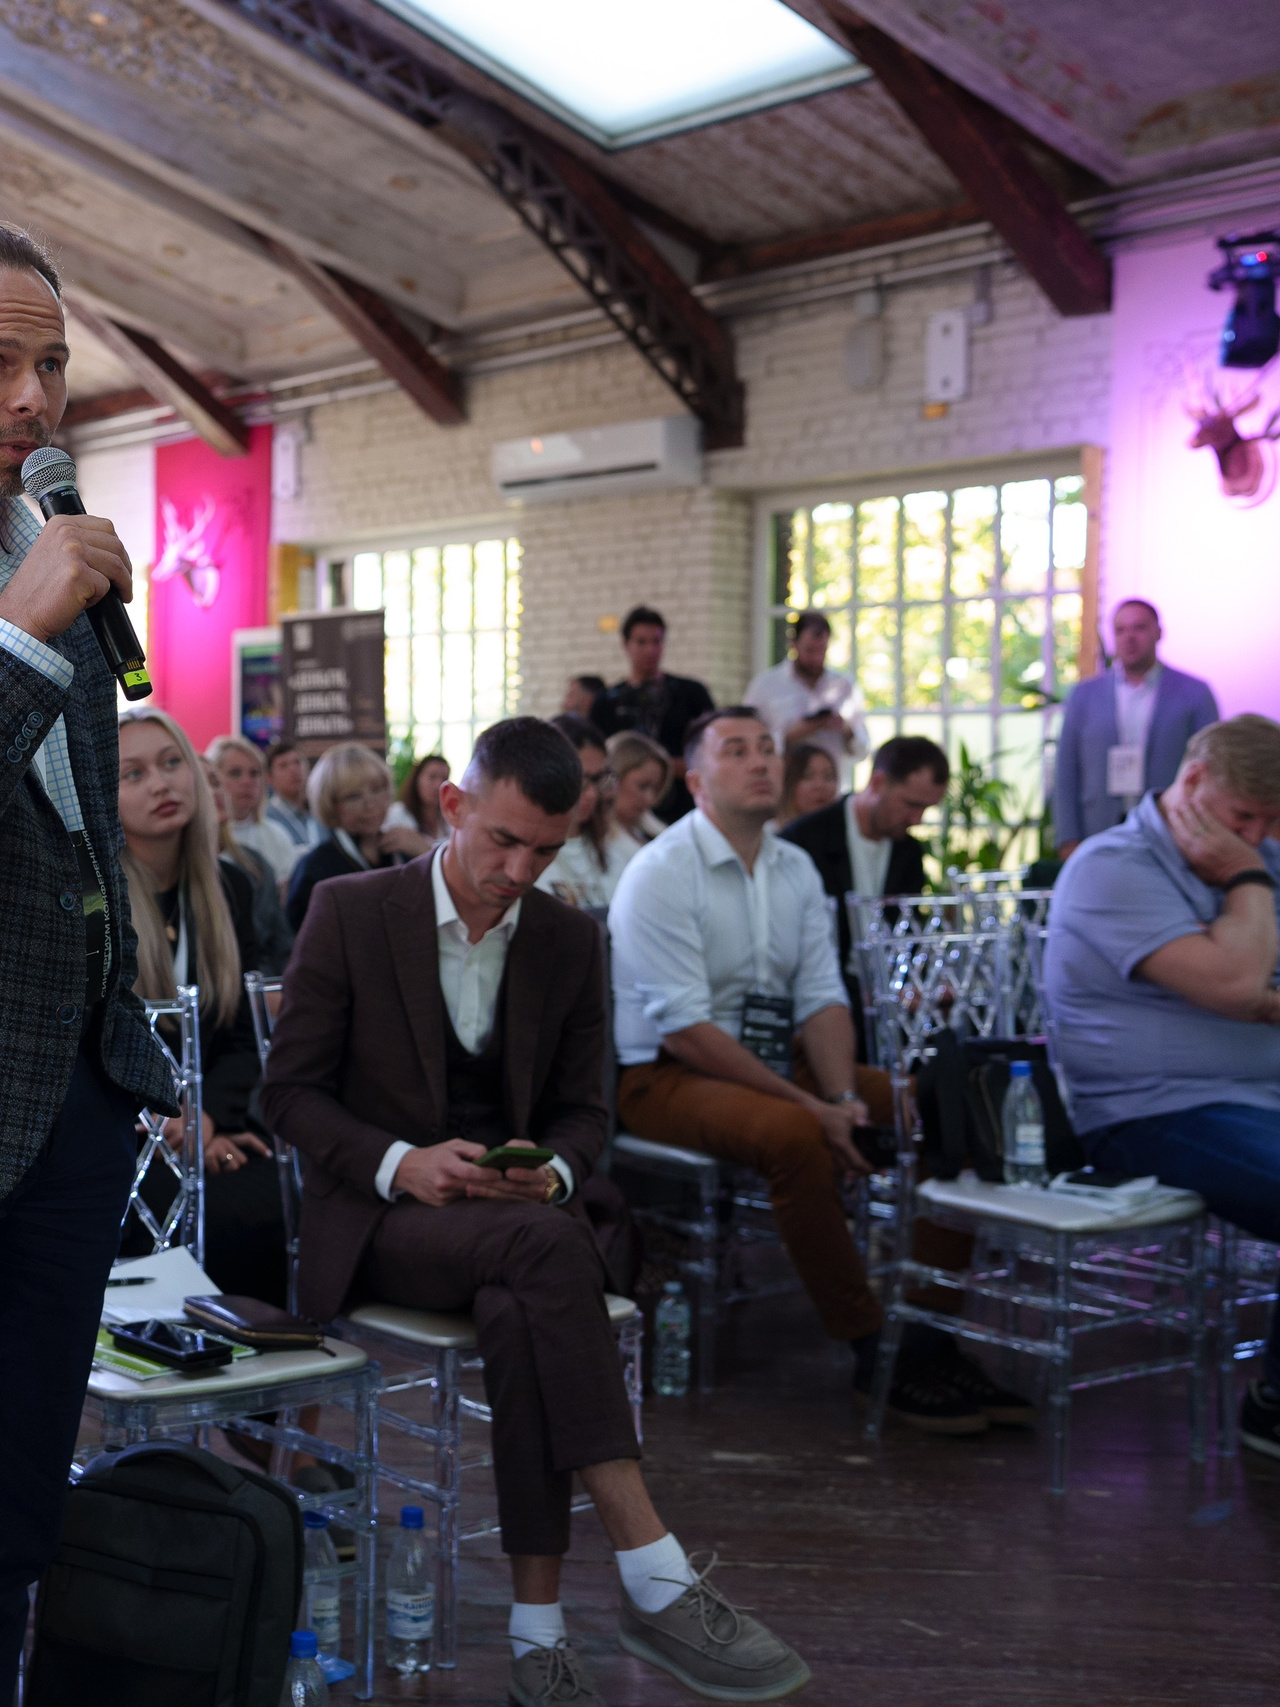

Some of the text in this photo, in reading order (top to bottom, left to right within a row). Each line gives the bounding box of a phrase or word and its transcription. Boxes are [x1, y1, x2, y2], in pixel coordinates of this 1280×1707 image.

[134, 672, 143, 681] 3
[82, 830, 111, 998] СИНЕРГИУМ КОНФЕРЕНЦИЯ
